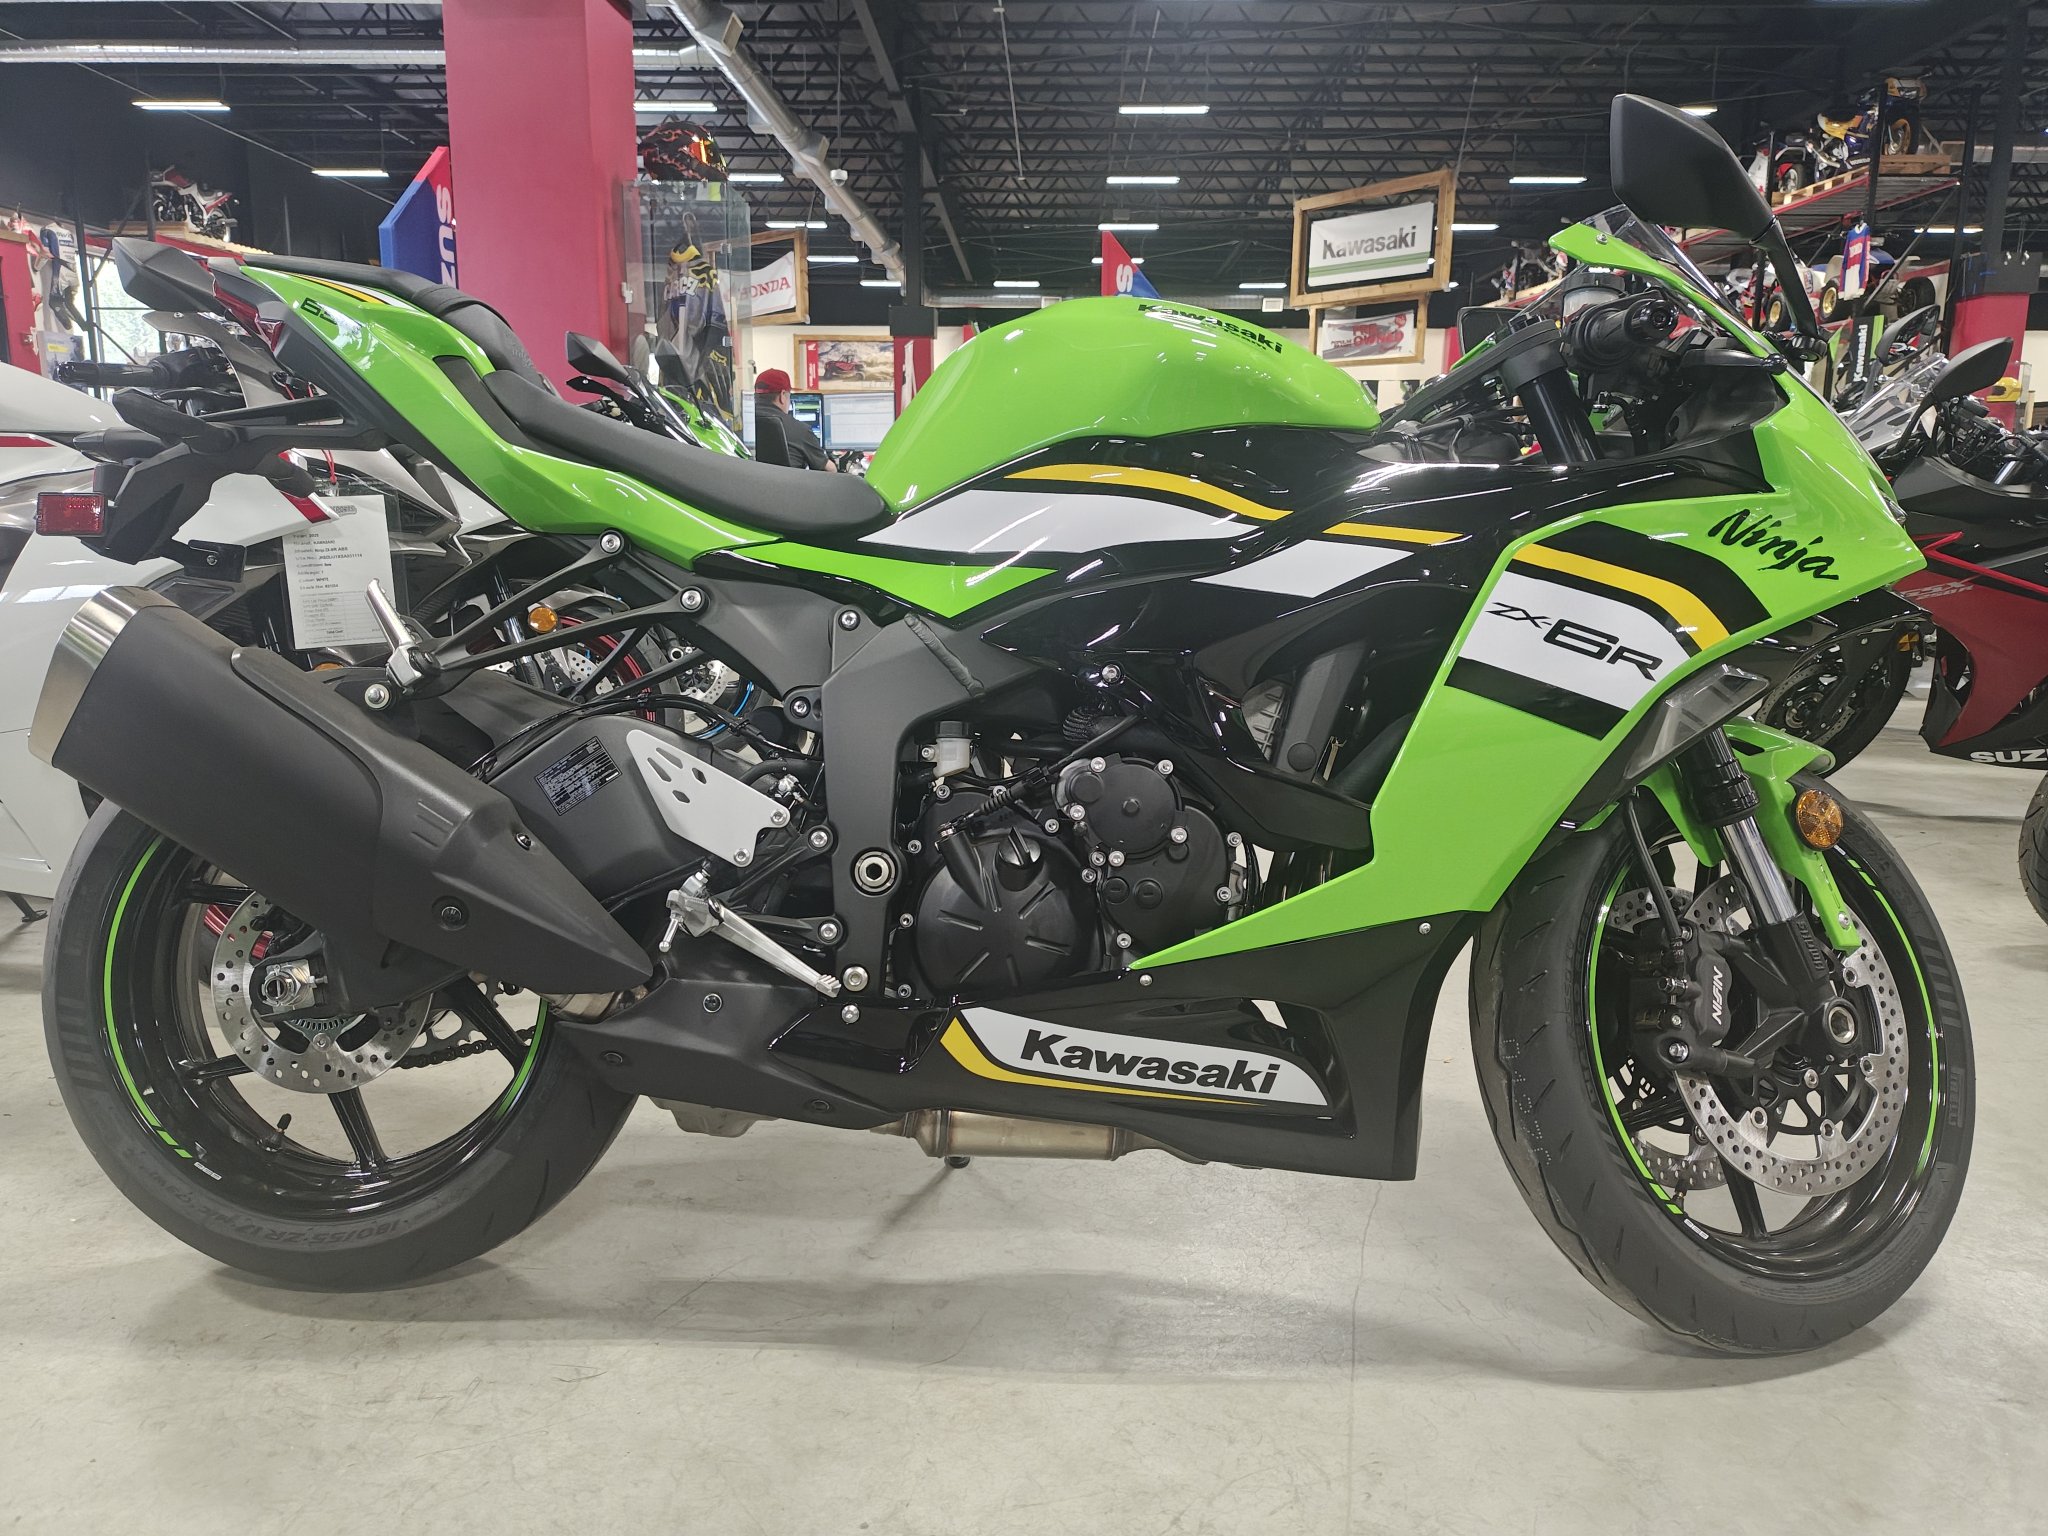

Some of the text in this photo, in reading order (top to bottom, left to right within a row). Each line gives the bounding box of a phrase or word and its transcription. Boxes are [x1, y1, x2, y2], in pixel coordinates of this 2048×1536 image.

[1322, 225, 1417, 260] Kawasaki
[1115, 263, 1134, 297] S
[1853, 324, 1868, 382] Kawasaki
[1707, 508, 1839, 581] Ninja
[1485, 602, 1663, 682] ZX-6R
[1711, 965, 1723, 1026] NISSIN
[1020, 1028, 1281, 1094] Kawasaki
